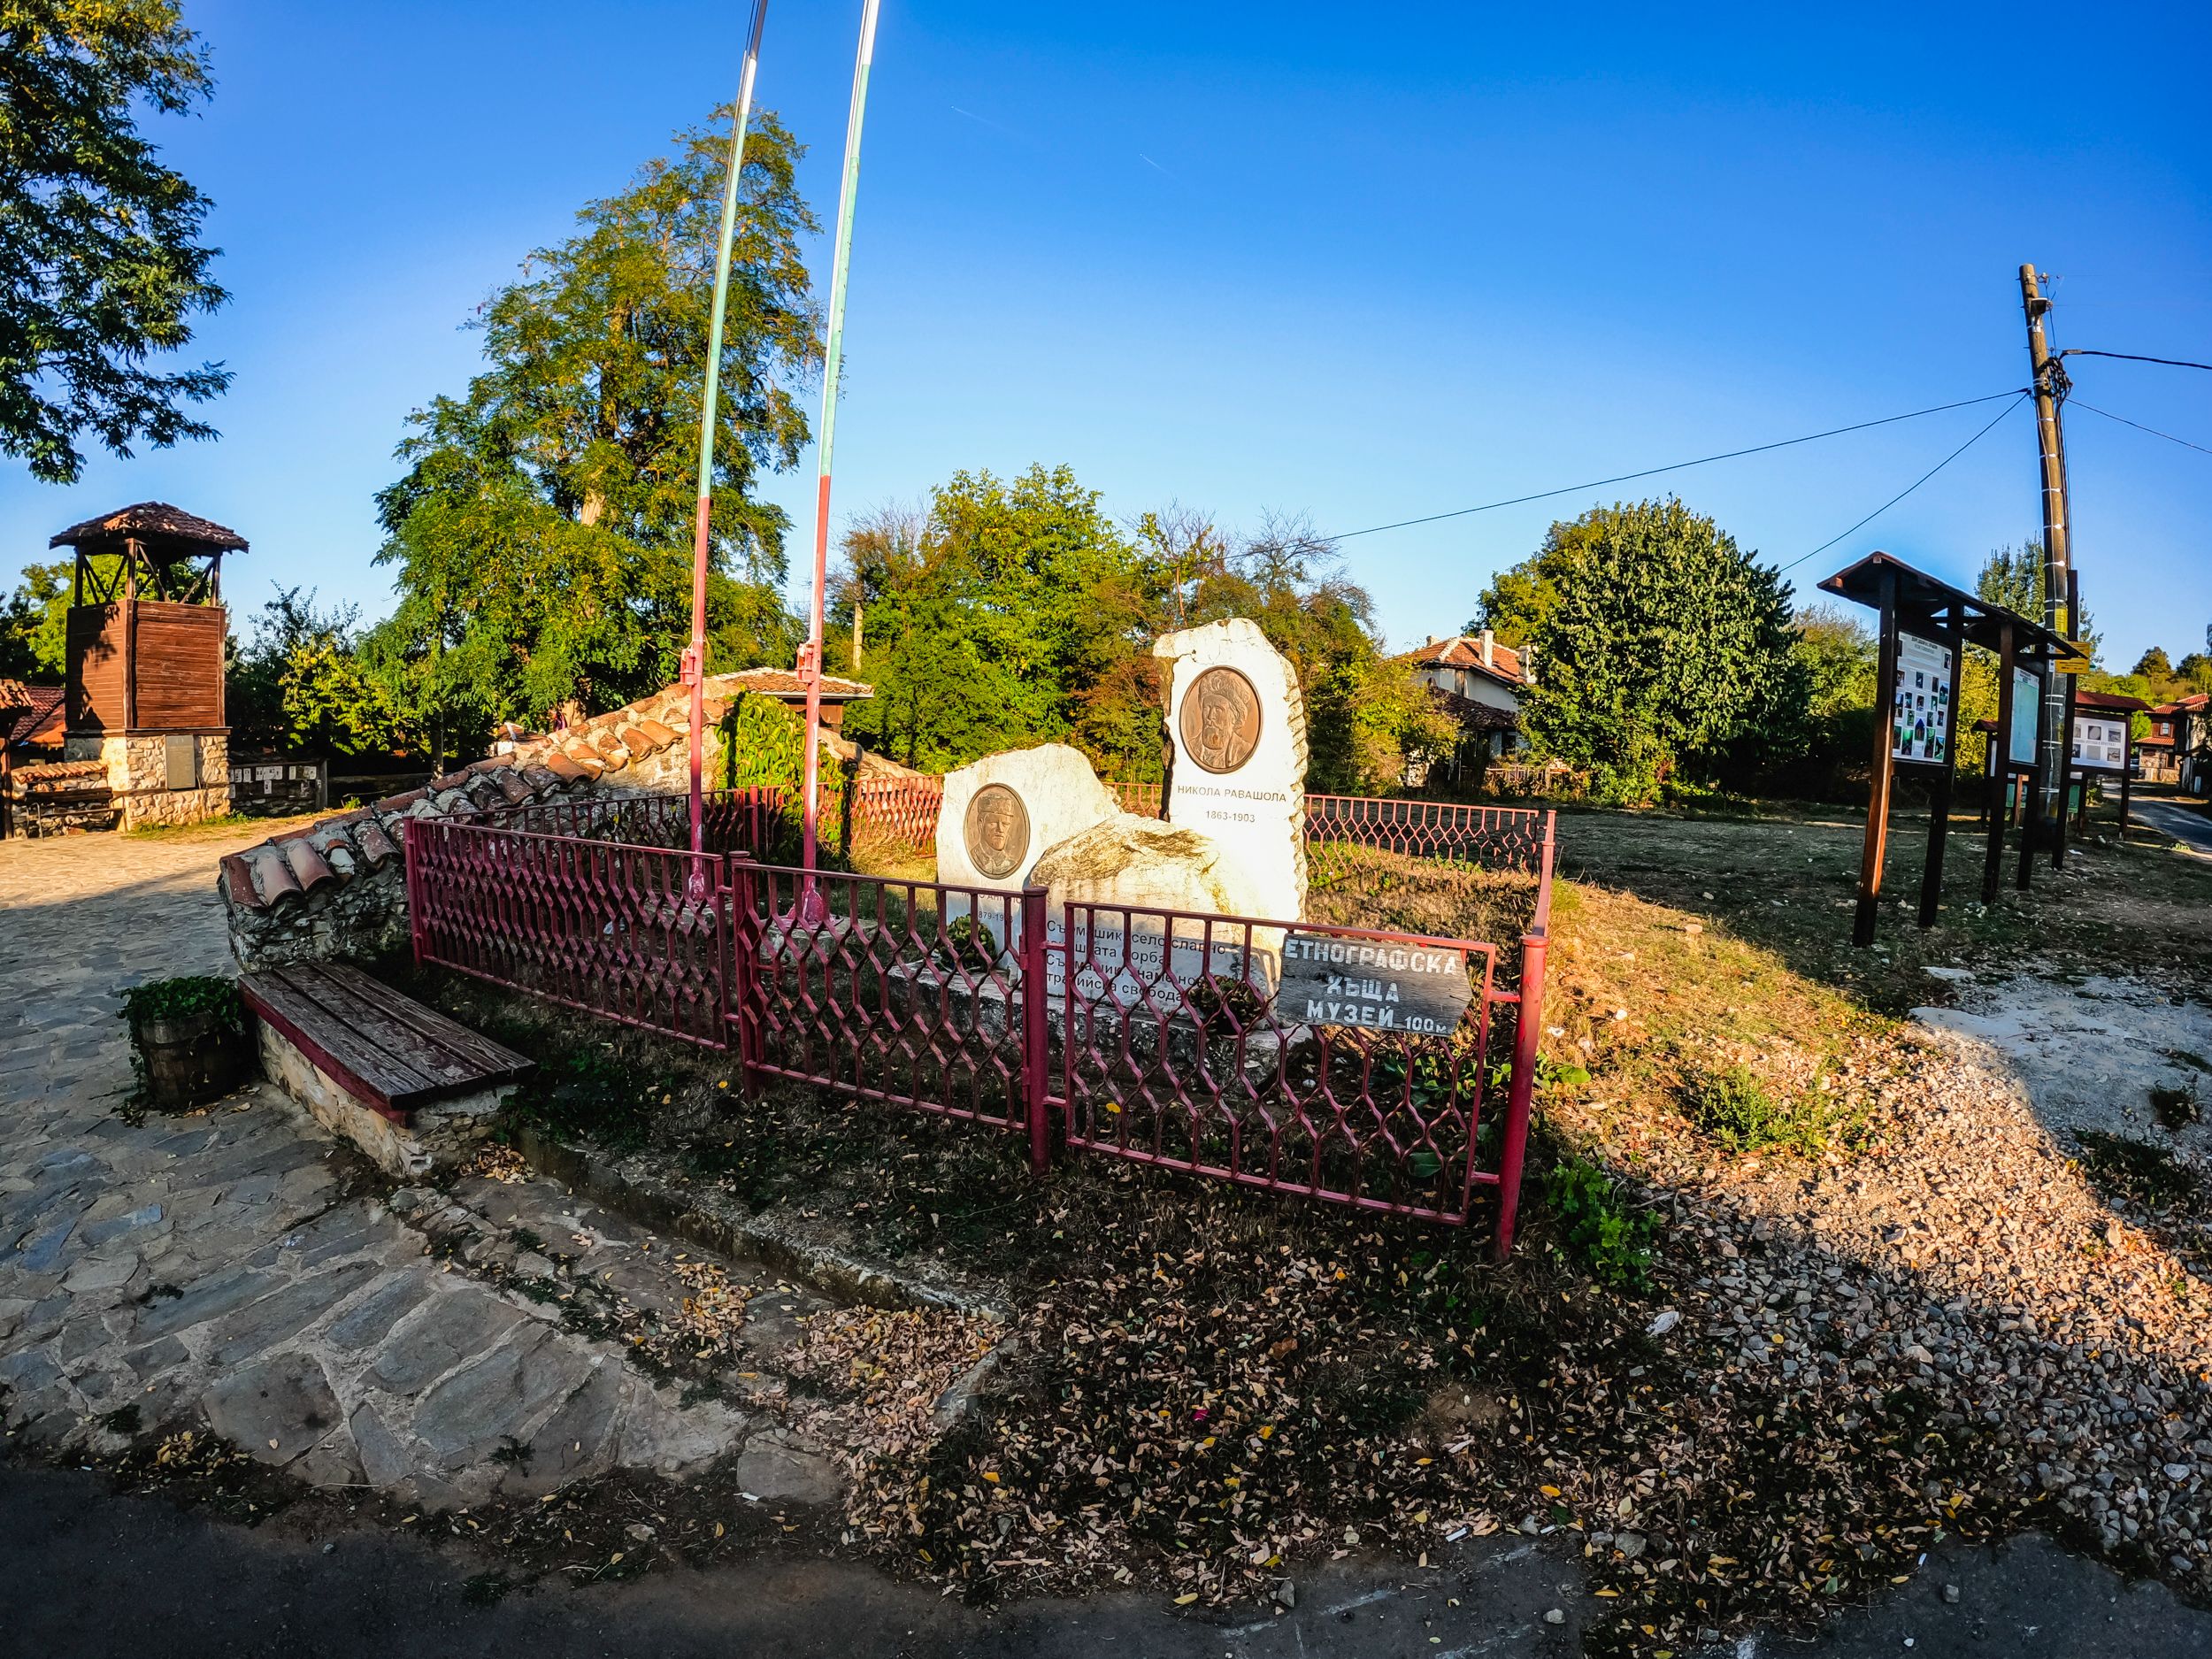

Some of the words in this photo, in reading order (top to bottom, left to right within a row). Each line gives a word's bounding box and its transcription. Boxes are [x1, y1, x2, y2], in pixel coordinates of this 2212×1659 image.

[1178, 785, 1221, 797] НИКОЛА
[1224, 788, 1286, 803] РАВАШОЛА
[1206, 810, 1256, 823] 1863-1903
[1047, 920, 1123, 941] Съмшик
[1124, 951, 1164, 964] орба
[1284, 938, 1457, 975] ЕТНОГРАФСКА
[1307, 1000, 1394, 1028] МУЗЕЙ
